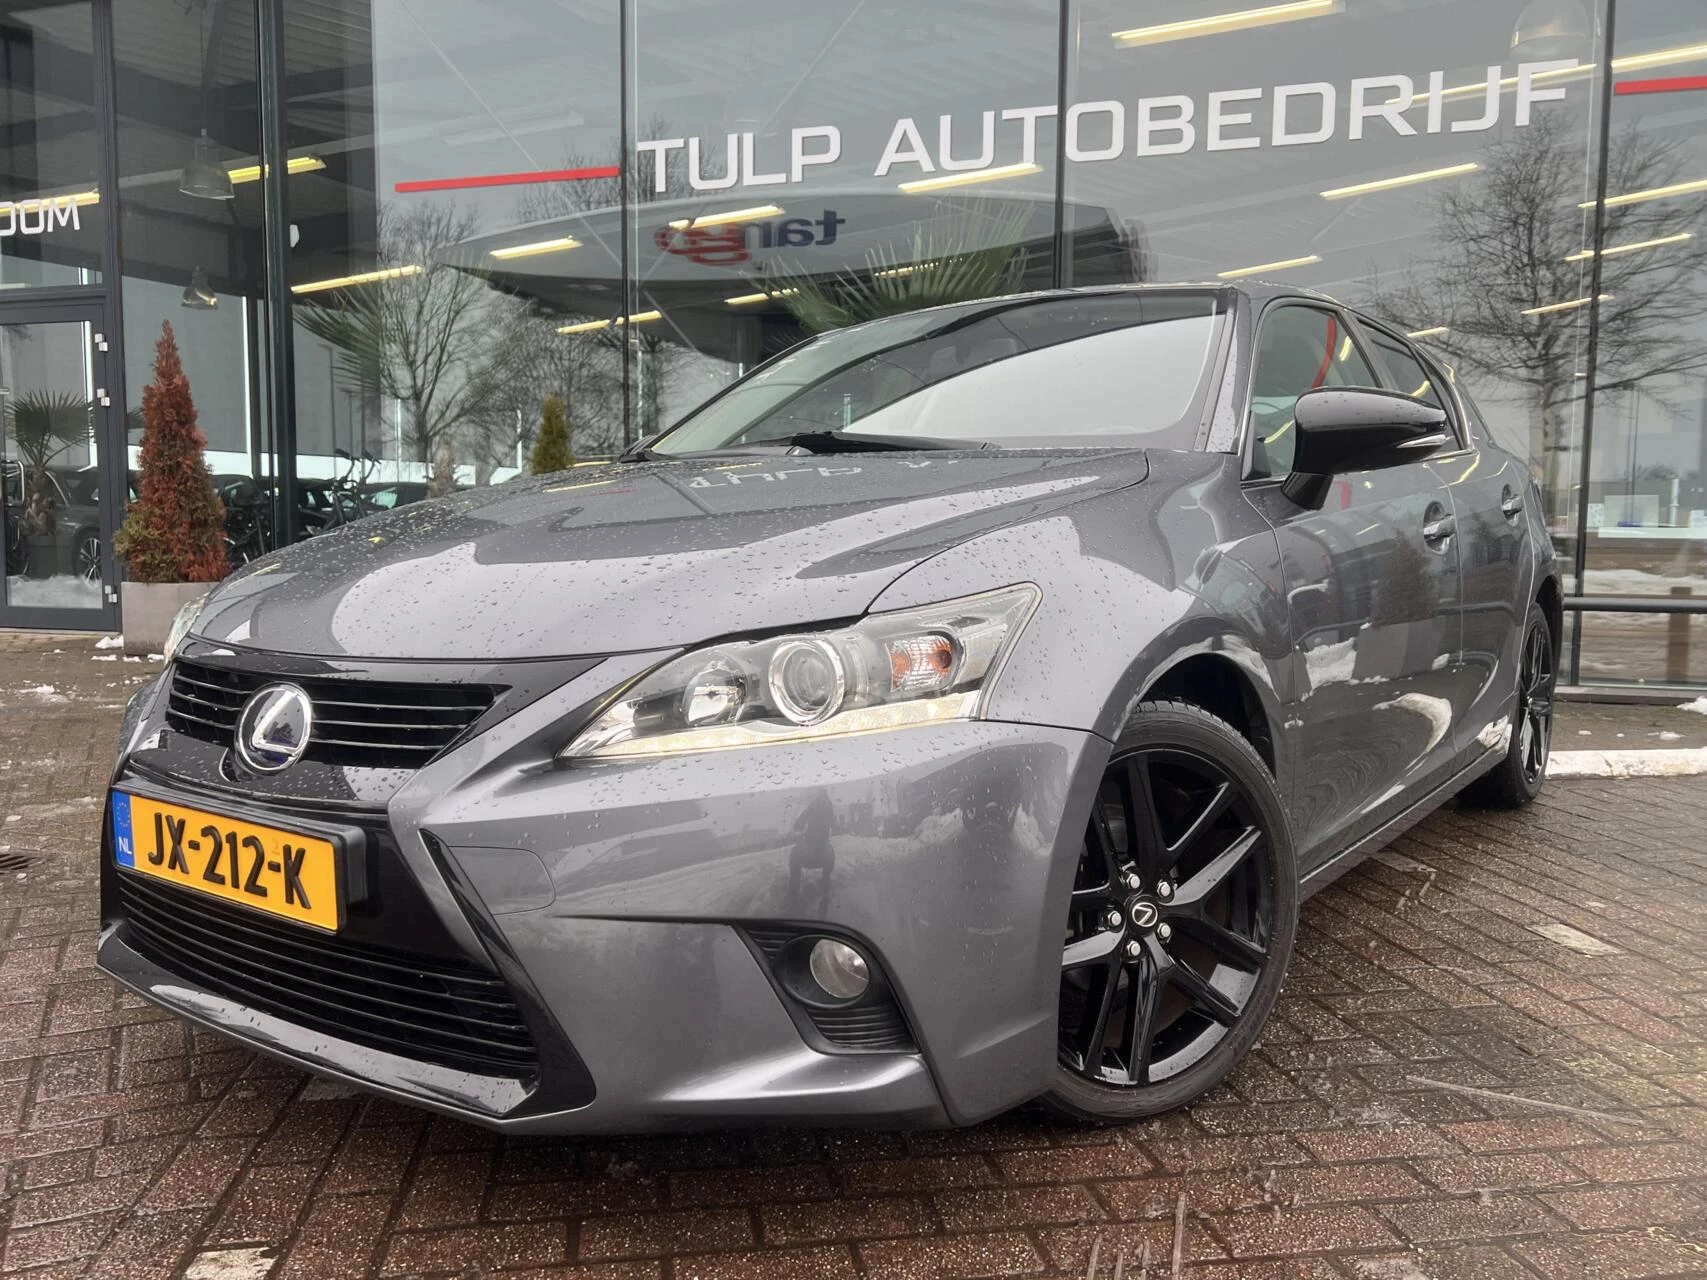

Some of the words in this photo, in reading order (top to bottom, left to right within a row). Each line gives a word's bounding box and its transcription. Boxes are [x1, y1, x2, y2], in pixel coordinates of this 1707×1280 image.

[637, 125, 841, 193] TULP
[874, 58, 1579, 177] AUTOBEDRIJF
[118, 836, 133, 855] NL
[148, 812, 312, 910] JX-212-K
